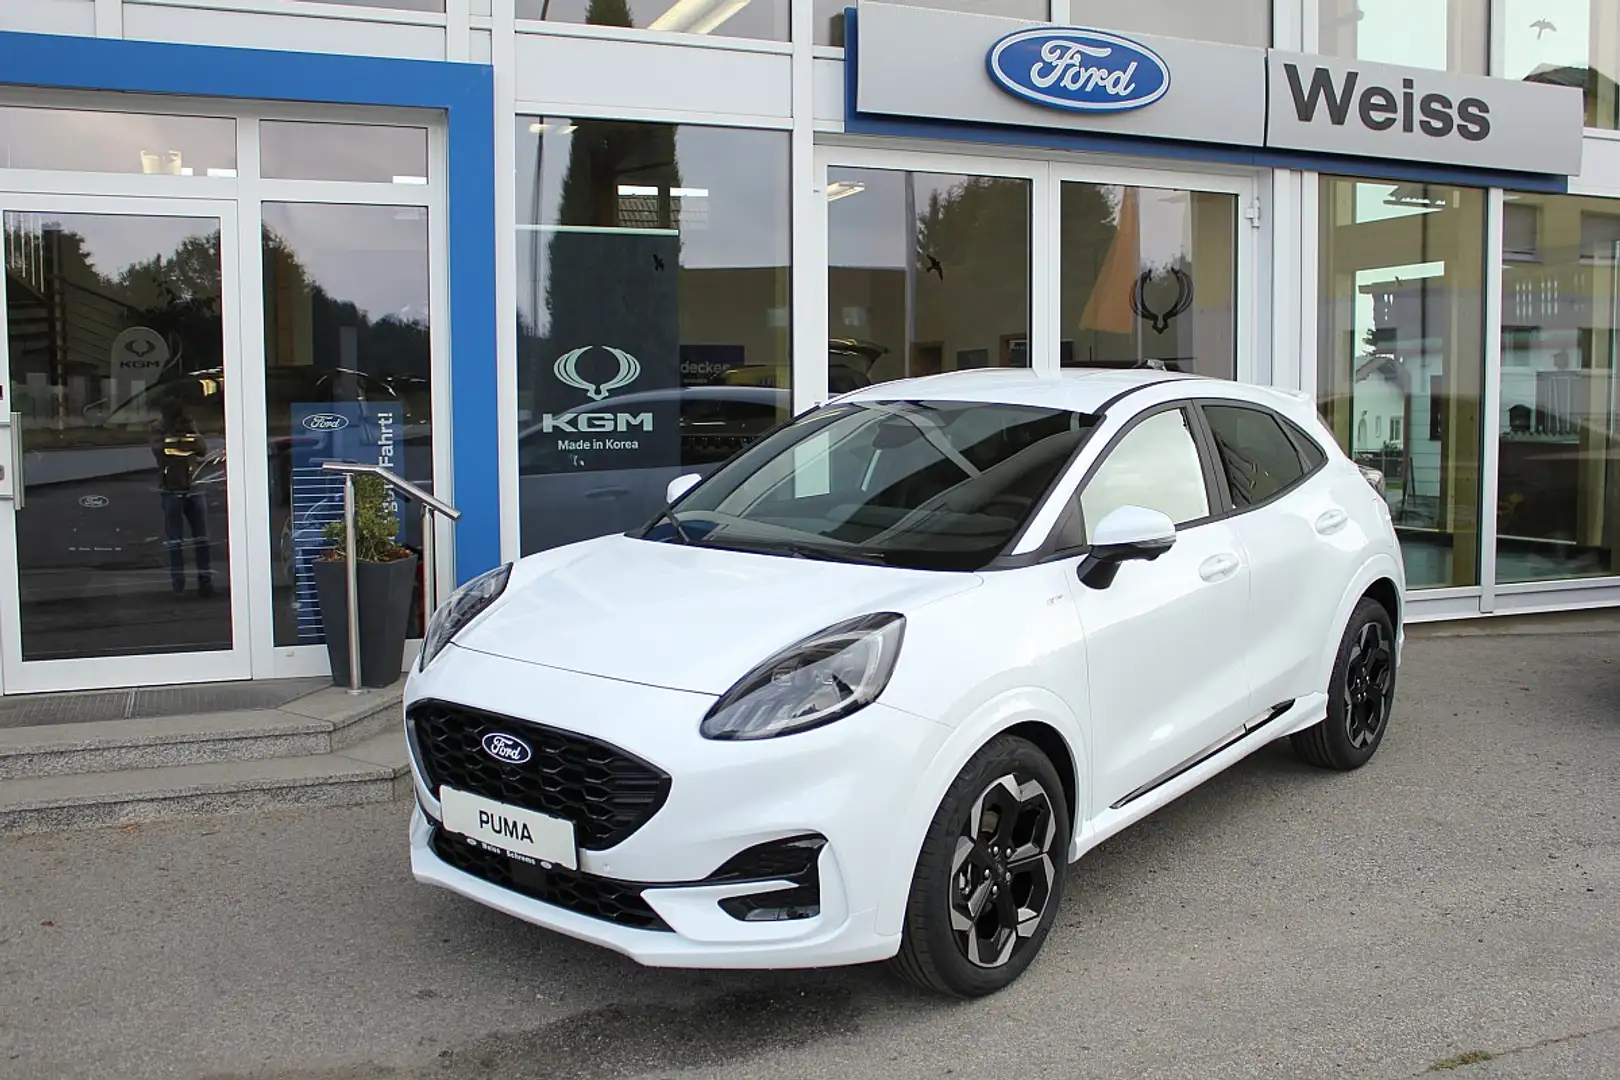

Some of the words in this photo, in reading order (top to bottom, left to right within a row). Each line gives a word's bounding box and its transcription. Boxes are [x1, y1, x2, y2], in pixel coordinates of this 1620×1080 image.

[1030, 40, 1138, 96] Ford
[1283, 63, 1491, 142] Weiss
[310, 415, 341, 428] Ford
[542, 412, 654, 433] KGM
[378, 413, 394, 467] Fahrt!
[557, 440, 591, 451] Made
[592, 439, 604, 450] in
[605, 438, 639, 450] Korea
[490, 736, 521, 760] Ford
[479, 810, 534, 844] PUMA
